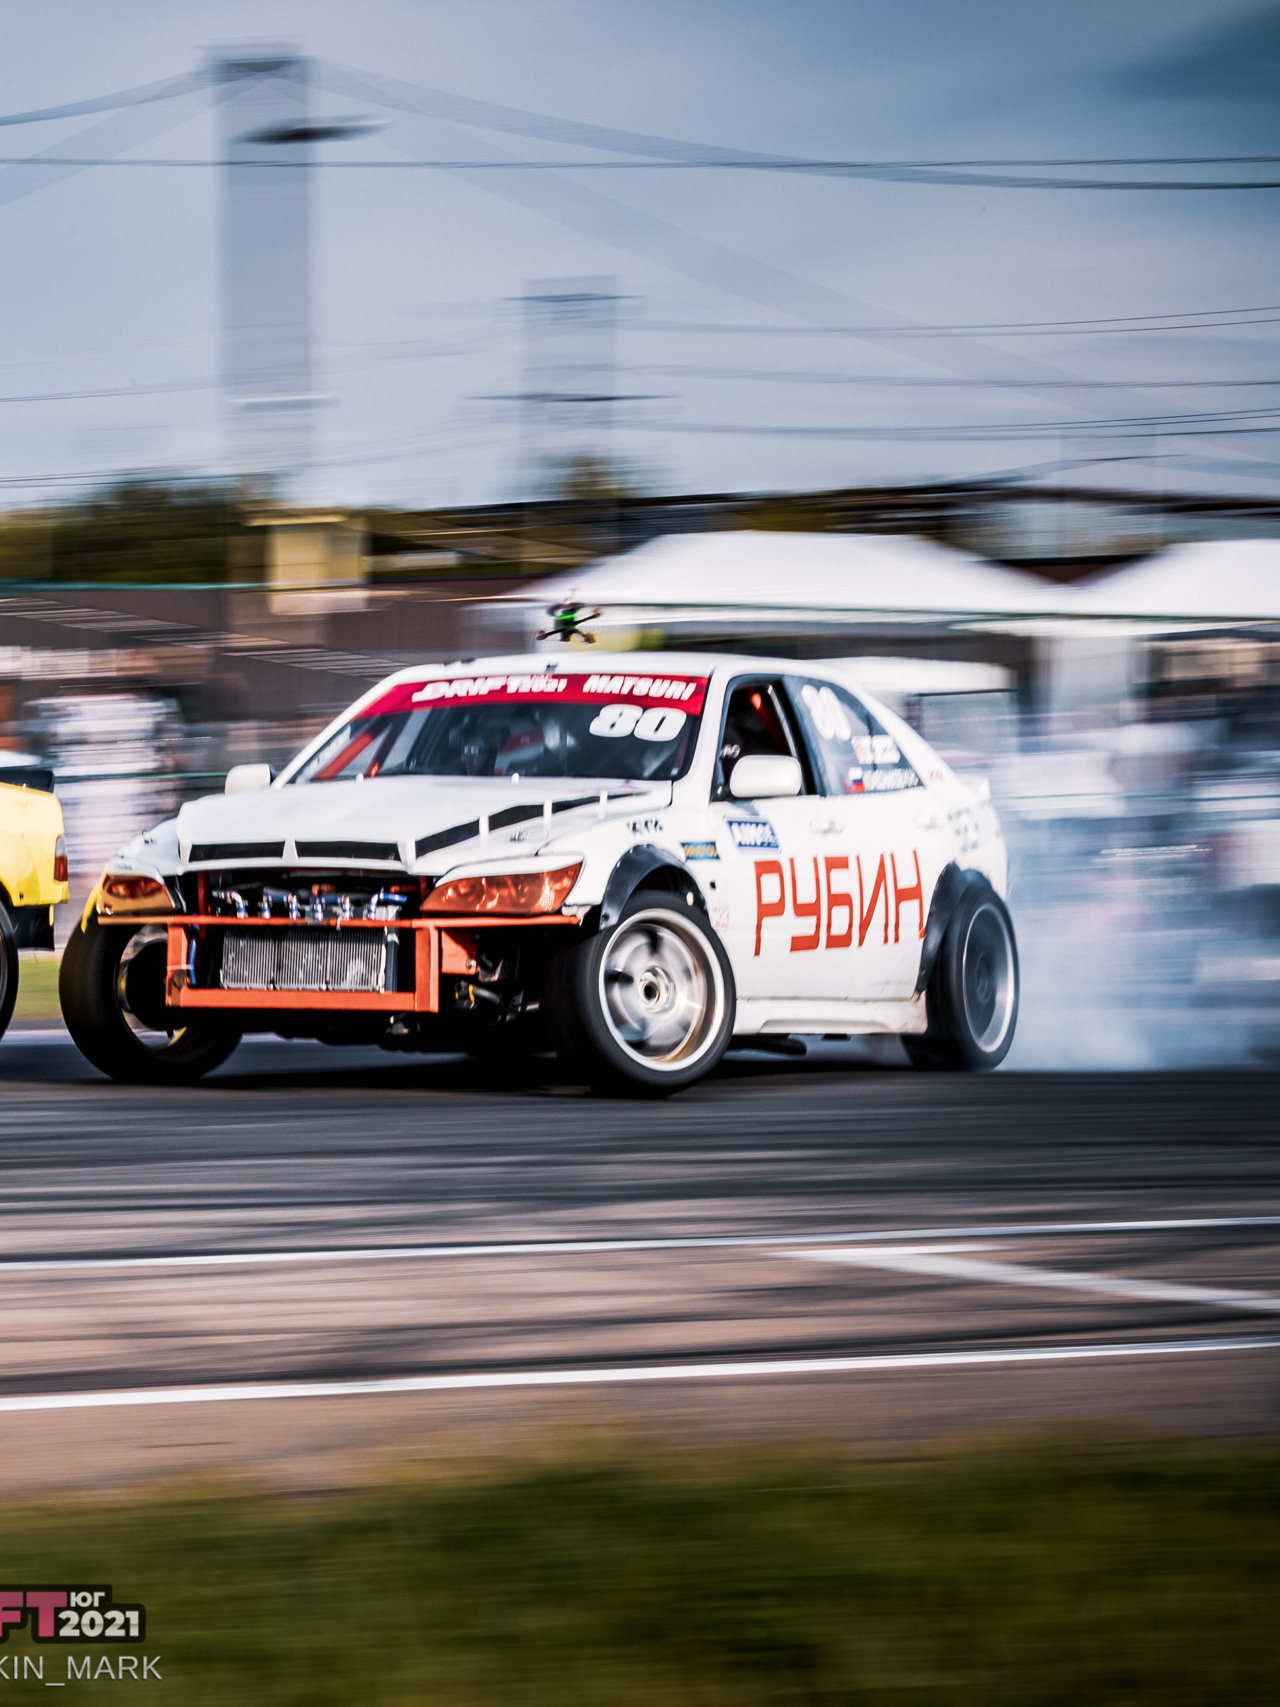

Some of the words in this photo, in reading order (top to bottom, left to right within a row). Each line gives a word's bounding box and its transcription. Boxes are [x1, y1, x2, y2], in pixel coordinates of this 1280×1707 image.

[582, 674, 697, 701] MATSURI
[588, 703, 687, 742] 80
[753, 850, 926, 957] РУБИН
